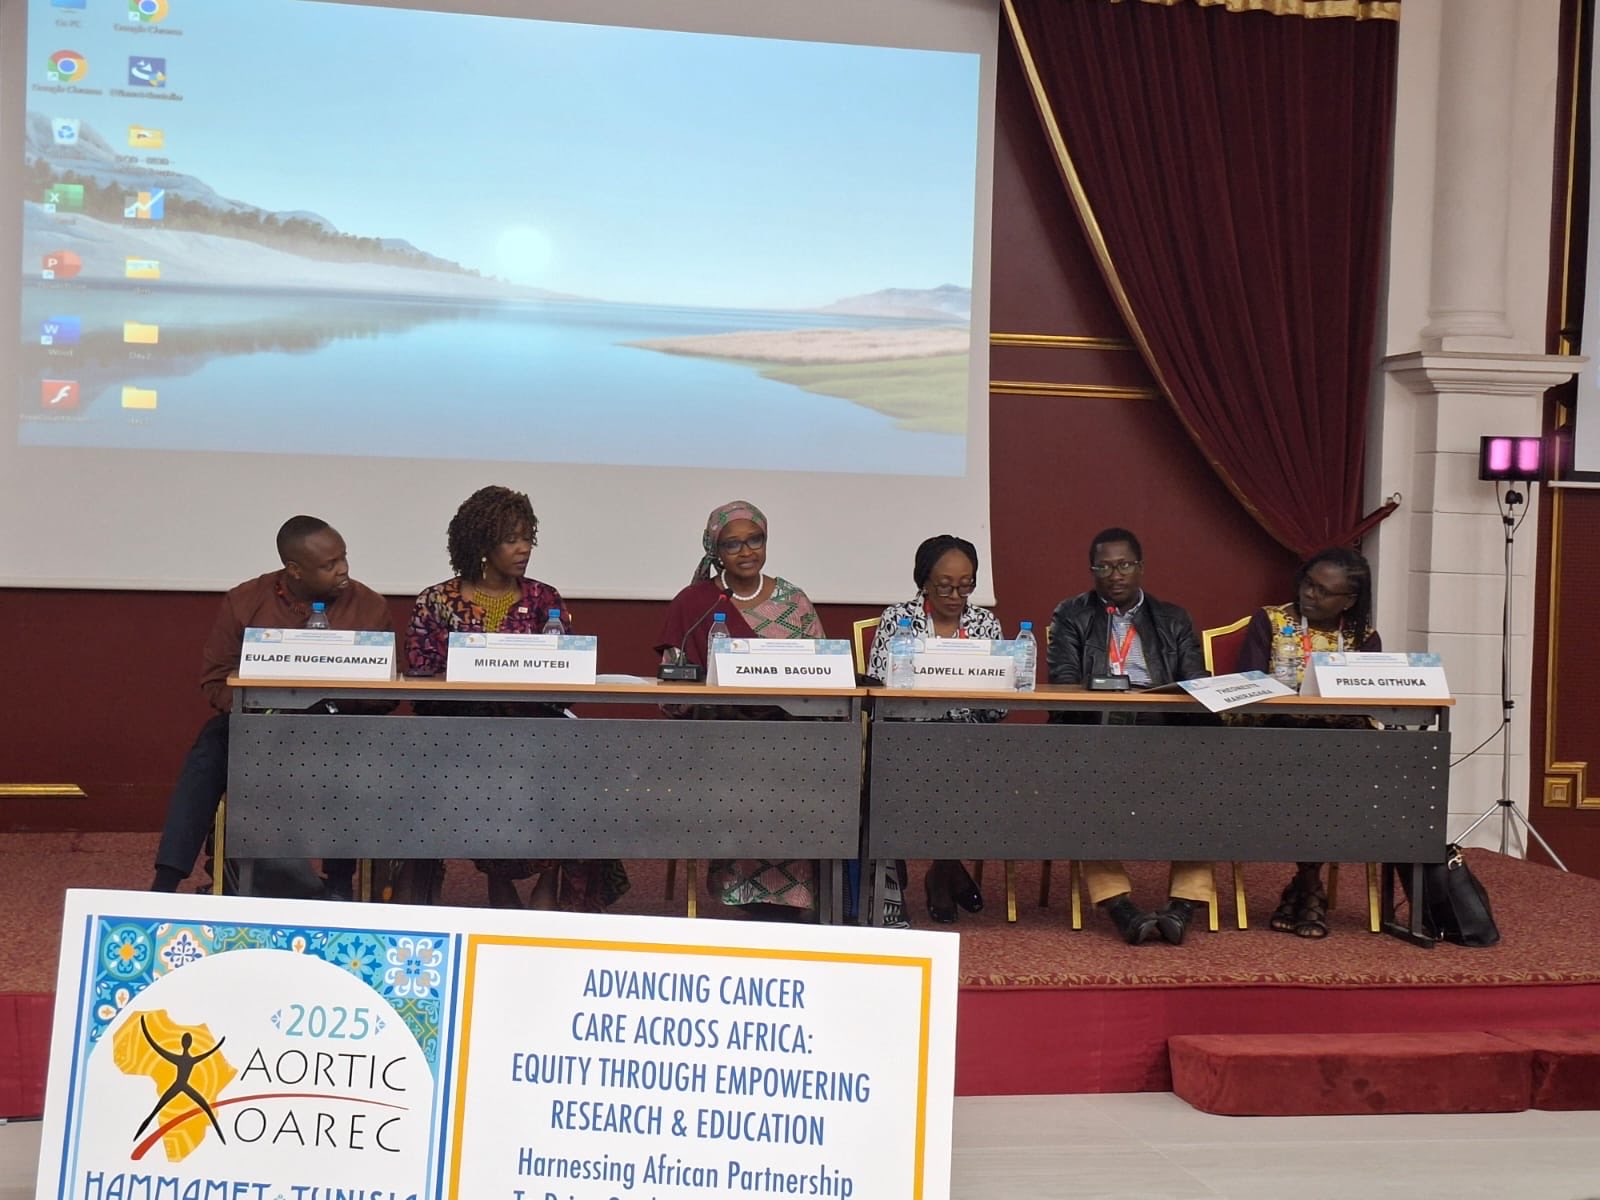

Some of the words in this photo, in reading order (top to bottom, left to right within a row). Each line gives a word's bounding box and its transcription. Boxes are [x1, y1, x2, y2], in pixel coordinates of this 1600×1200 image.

[44, 324, 59, 334] W
[245, 653, 291, 663] EULADE
[294, 655, 388, 665] RUGENGAMANZI
[474, 658, 520, 668] MIRIAM
[523, 659, 570, 669] MUTEBI
[735, 666, 778, 675] ZAINAB
[784, 666, 832, 675] BAGUDU
[911, 666, 964, 676] LADWELL
[968, 668, 1006, 677] KIARIE
[1335, 678, 1375, 686] PRISCA
[1377, 678, 1426, 686] GITHUKA
[583, 968, 710, 1004] ADVANCING
[719, 975, 805, 1009] CANCER
[285, 1004, 369, 1040] 2025
[572, 1012, 627, 1043] CARE
[633, 1015, 719, 1049] ACROSS
[726, 1021, 813, 1054] AFRICA:
[240, 1047, 407, 1092] AORTIC
[512, 1052, 592, 1086] EQUITY
[598, 1057, 707, 1093] THROUGH
[715, 1064, 870, 1103] EMPOWERING
[234, 1107, 401, 1153] OAREC
[551, 1099, 662, 1135] RESEARCH
[671, 1109, 688, 1137] &
[697, 1108, 824, 1146] EDUCATION
[518, 1147, 635, 1190] Harnessing
[642, 1153, 718, 1188] African
[727, 1160, 853, 1200] Partnership
